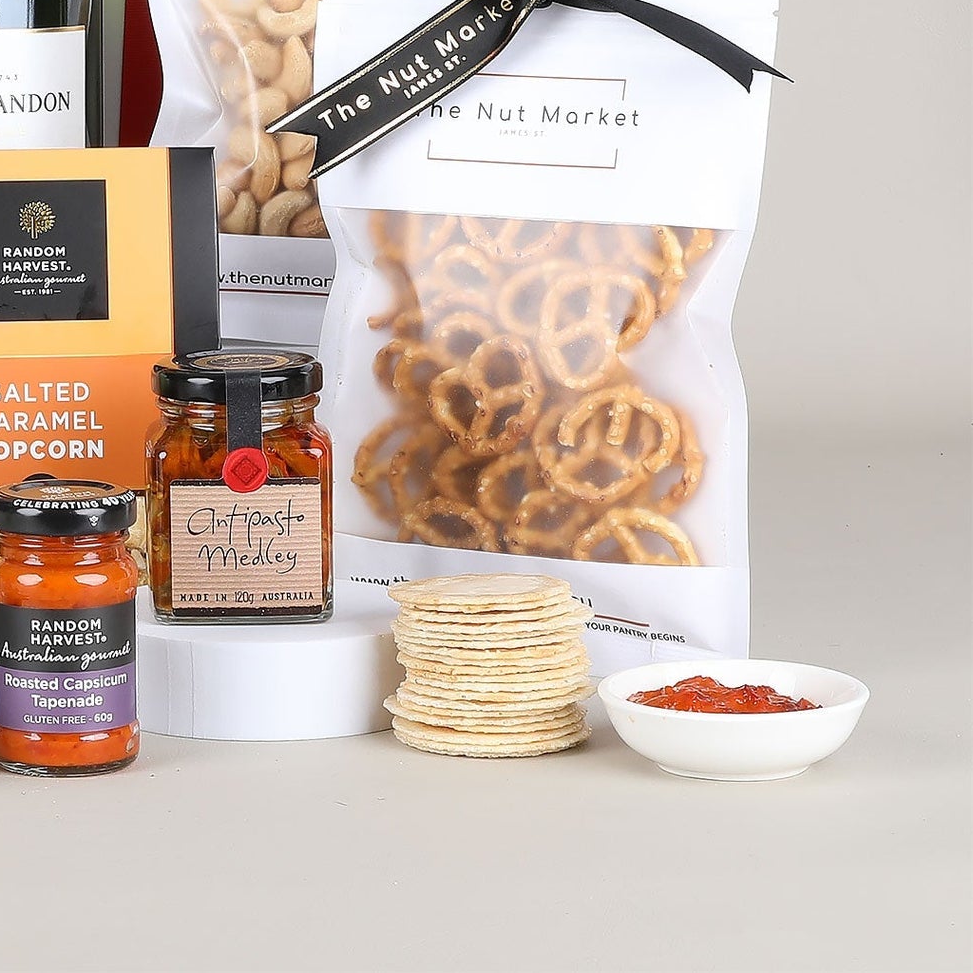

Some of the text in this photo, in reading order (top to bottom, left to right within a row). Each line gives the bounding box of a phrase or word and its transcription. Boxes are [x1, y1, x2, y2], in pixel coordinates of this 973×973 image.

[403, 55, 467, 99] JAMES ST.
[316, 93, 372, 130] The
[378, 53, 431, 95] Nut
[418, 102, 639, 127] he Nut Market
[3, 246, 66, 258] RANDOM
[44, 273, 87, 288] gourmet
[21, 288, 37, 296] EST.
[13, 499, 100, 510] CELEBRATING
[102, 495, 119, 507] 40
[198, 537, 298, 574] Medley
[180, 592, 314, 605] MADE IN 120g AUSTRALIA
[30, 618, 102, 632] RANDOM
[585, 621, 686, 644] YOUR PANTRY BEGINS
[1, 641, 132, 670] Australian gourmet
[4, 672, 128, 692] Roasted Capsicum
[31, 694, 104, 710] Tapenade
[23, 714, 60, 725] GLUTEN
[62, 714, 87, 725] FREE
[94, 713, 113, 726] 60g
